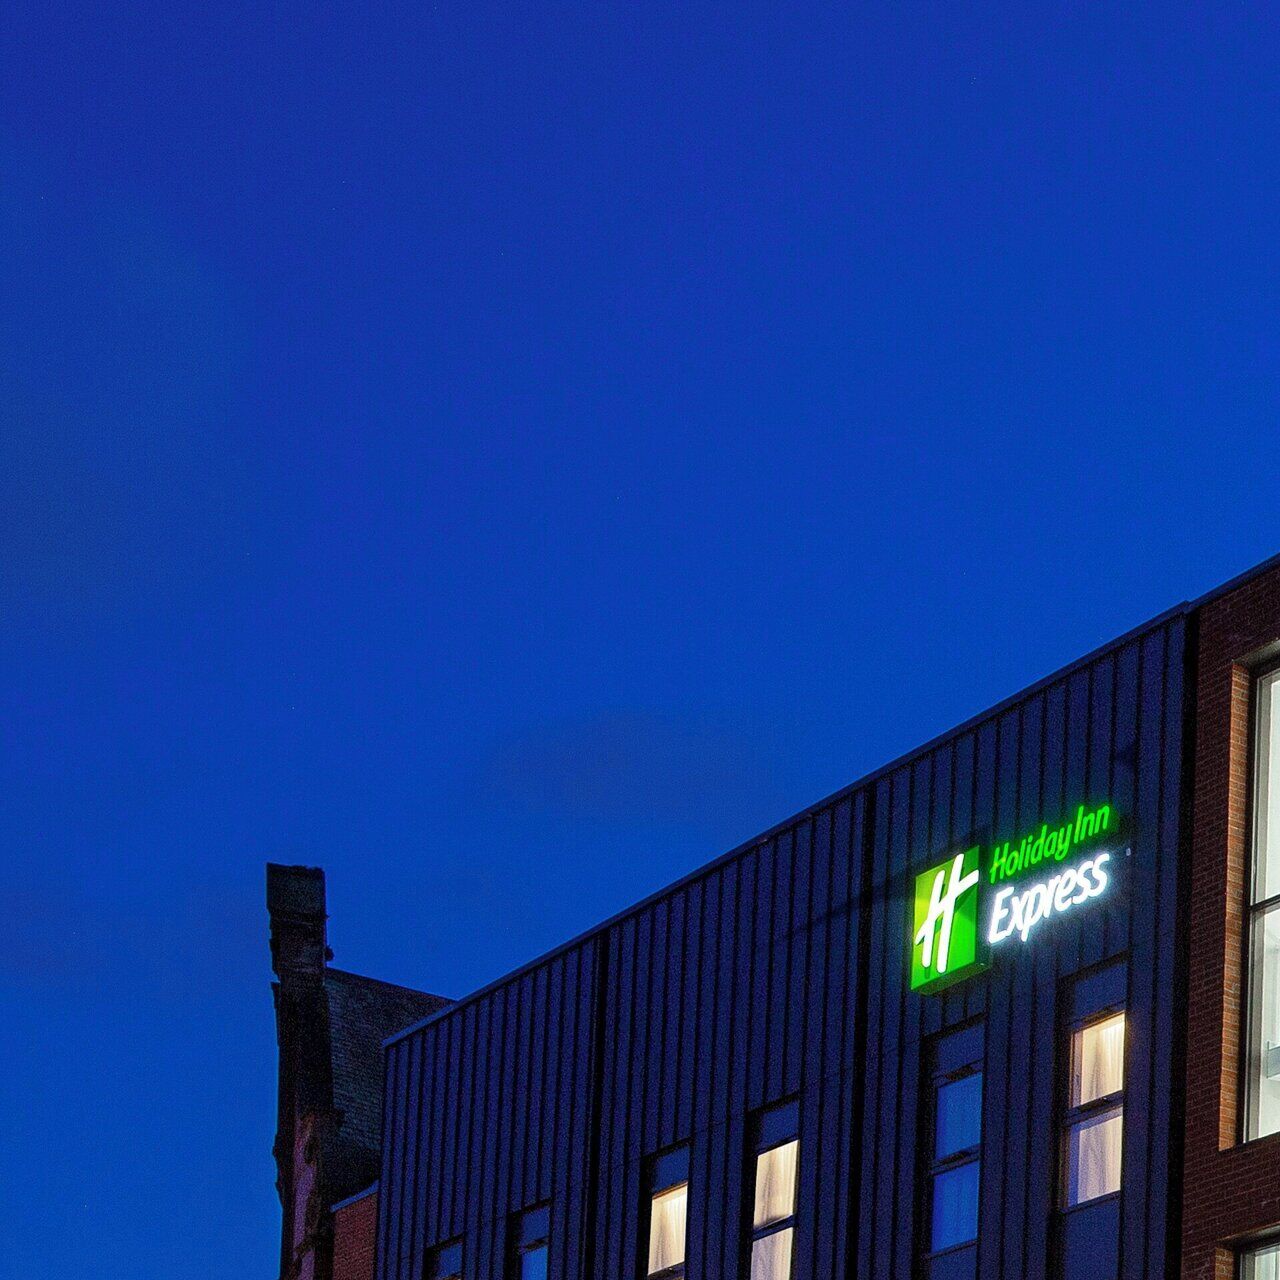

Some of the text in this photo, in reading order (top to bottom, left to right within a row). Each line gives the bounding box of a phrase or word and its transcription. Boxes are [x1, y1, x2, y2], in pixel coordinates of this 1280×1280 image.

[990, 805, 1110, 884] Holiday Inn
[988, 853, 1110, 942] Express
